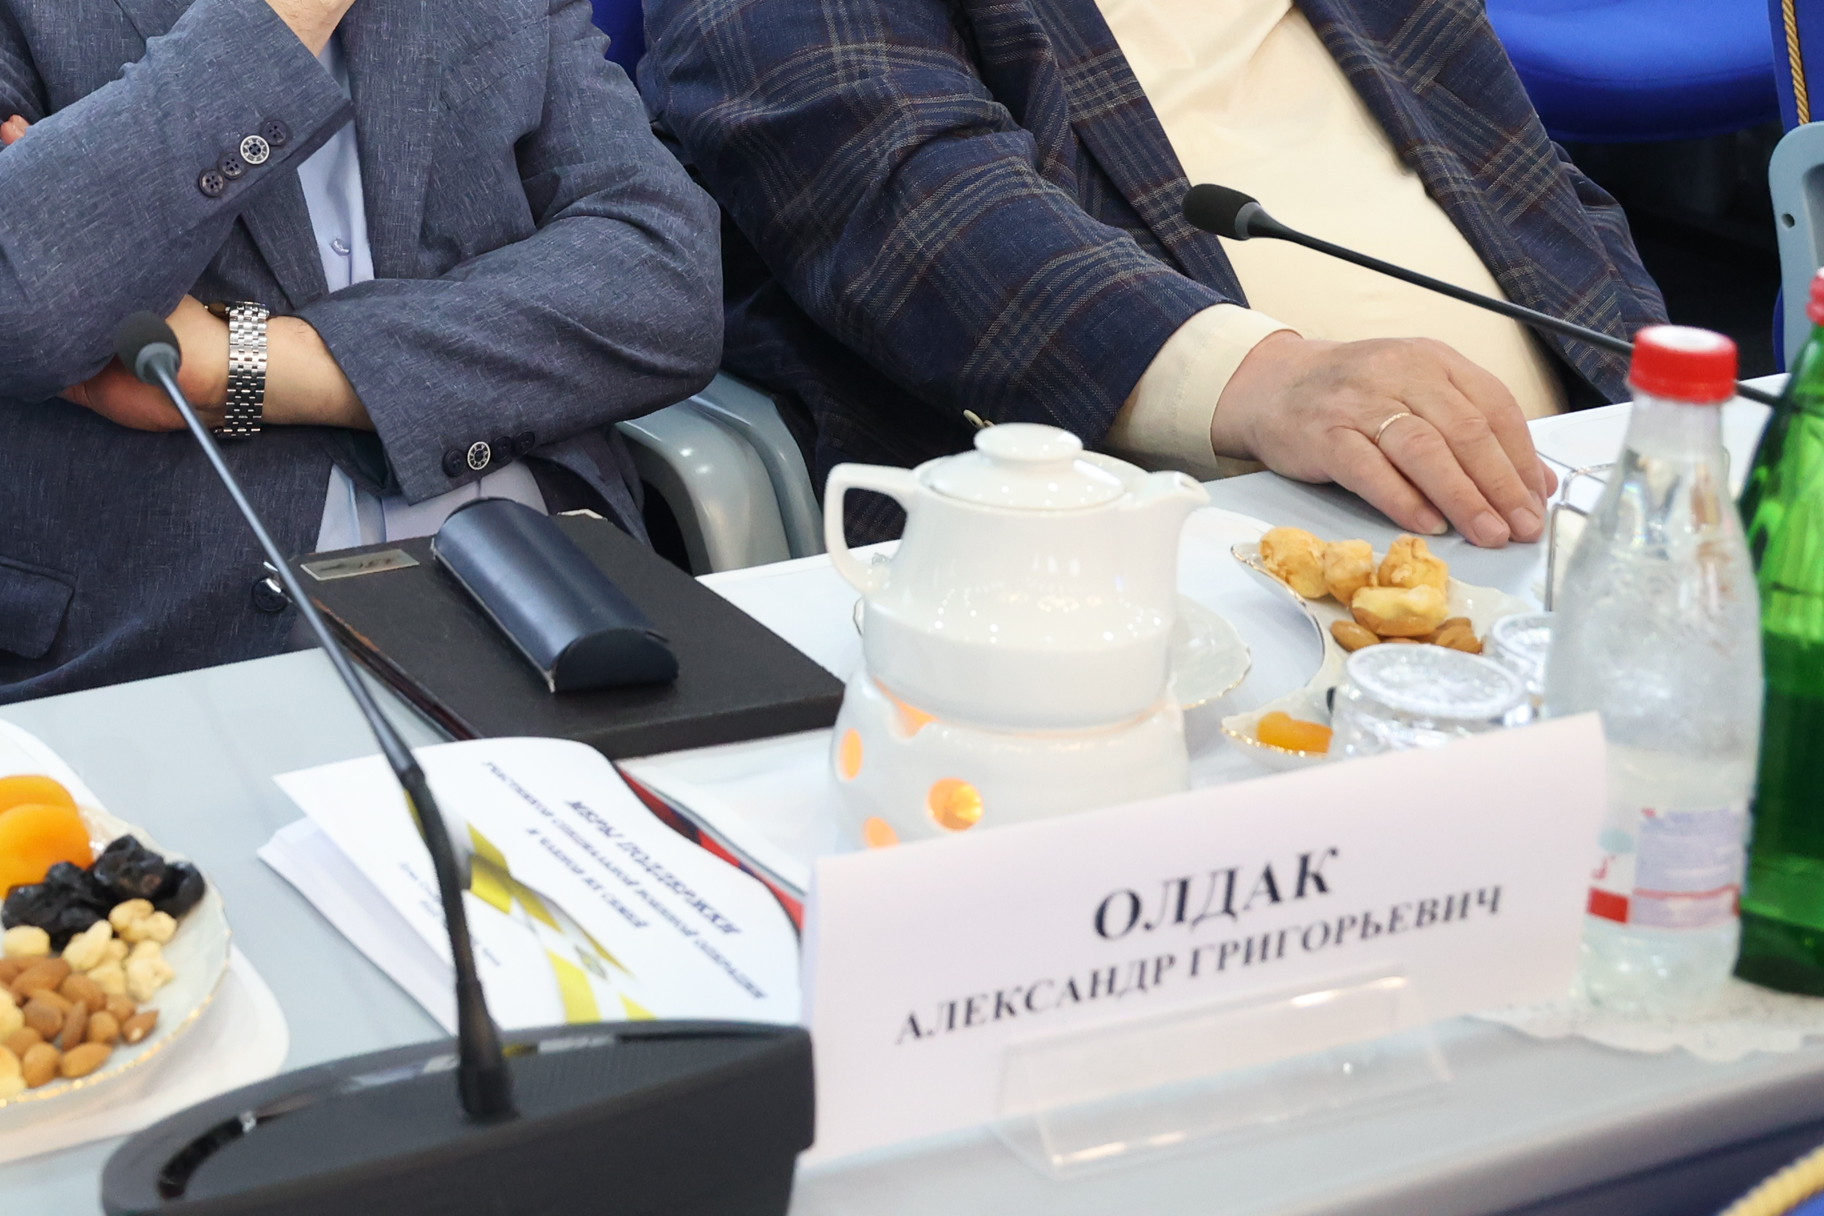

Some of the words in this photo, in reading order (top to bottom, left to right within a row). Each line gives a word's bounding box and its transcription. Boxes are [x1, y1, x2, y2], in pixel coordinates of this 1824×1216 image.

[1093, 846, 1340, 942] ОЛДАК
[894, 953, 1177, 1045] АЛЕКСАНДР
[1188, 885, 1503, 978] ГРИГОРЬЕВИЧ
